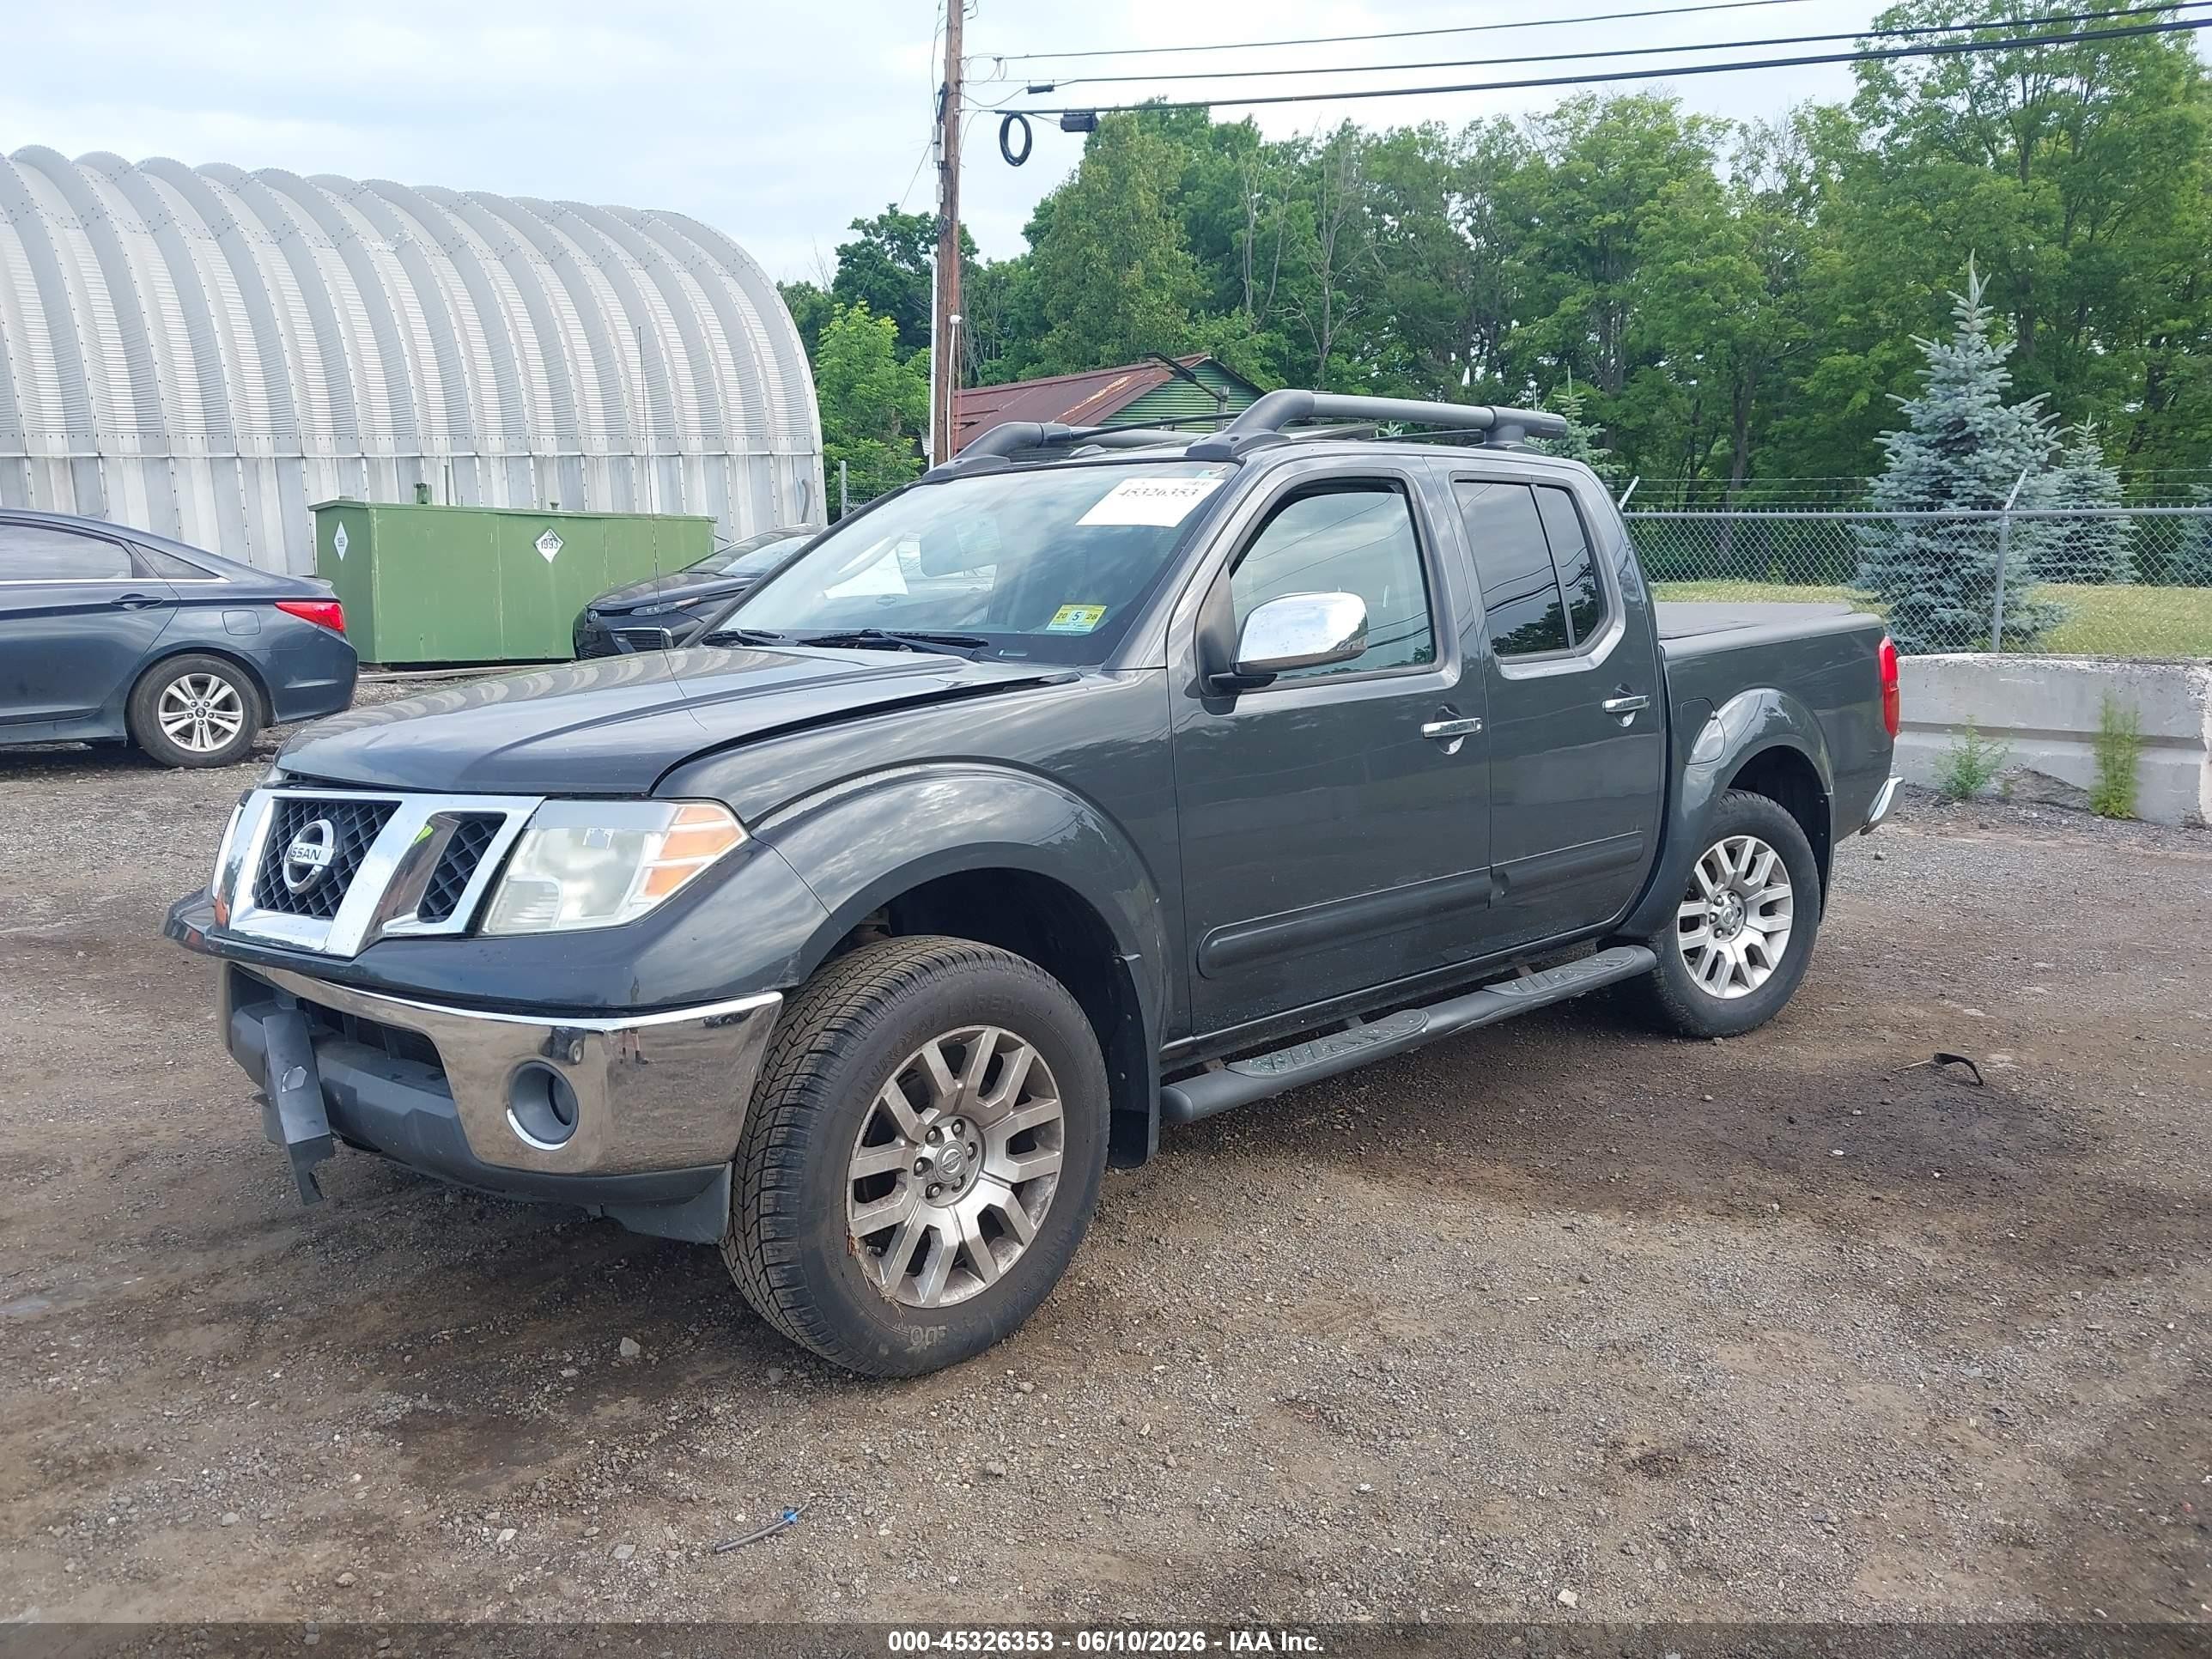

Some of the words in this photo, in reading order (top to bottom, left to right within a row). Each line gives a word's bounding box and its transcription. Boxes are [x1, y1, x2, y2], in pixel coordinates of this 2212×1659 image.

[541, 538, 558, 549] 1993
[1072, 611, 1082, 621] 5
[289, 847, 322, 860] SSAN
